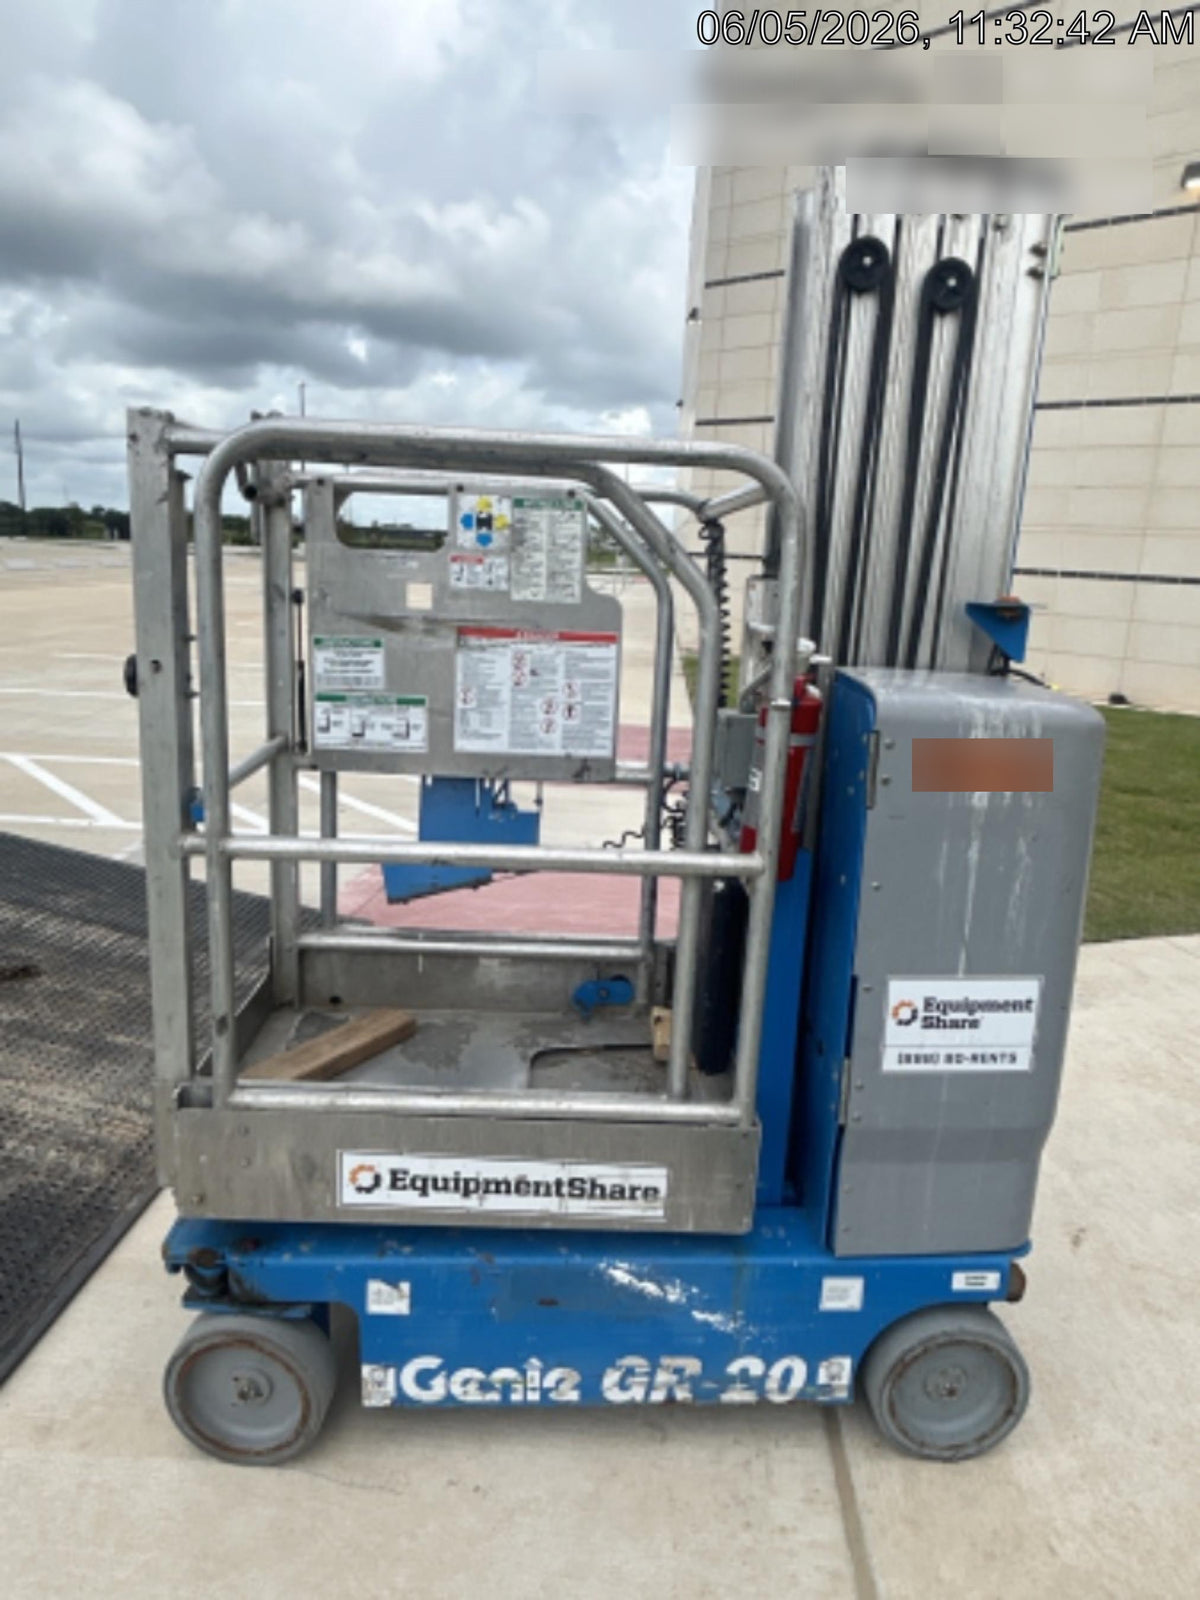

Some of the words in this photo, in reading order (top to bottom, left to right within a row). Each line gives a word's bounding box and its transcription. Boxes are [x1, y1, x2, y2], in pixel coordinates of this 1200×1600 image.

[922, 996, 1033, 1016] Equipment
[921, 1016, 980, 1029] Share
[388, 1167, 661, 1203] EquipmentShare
[399, 1354, 582, 1403] Genie
